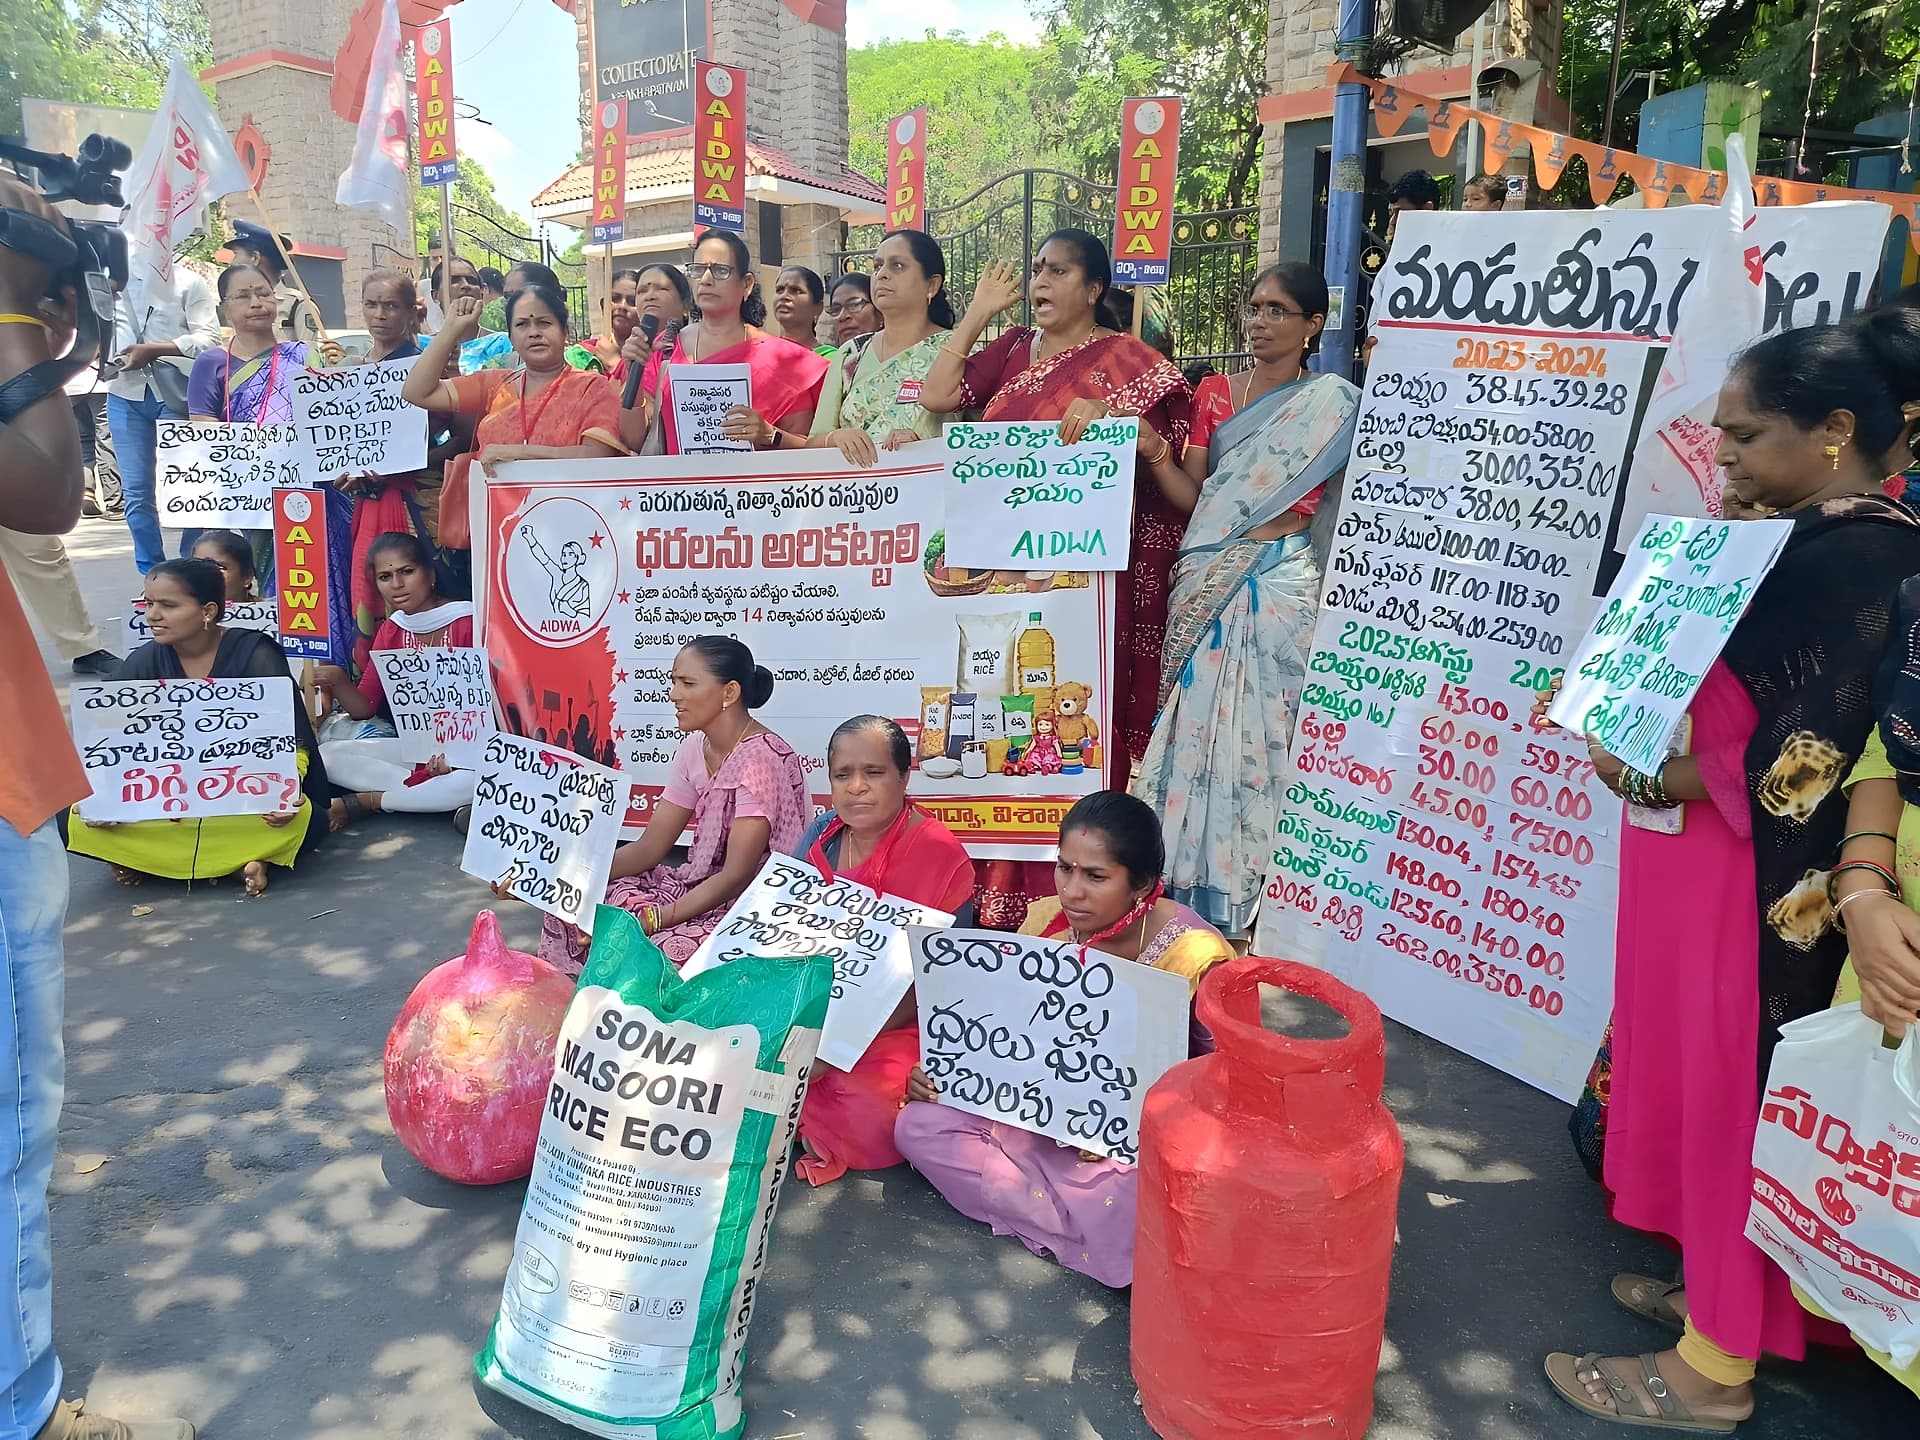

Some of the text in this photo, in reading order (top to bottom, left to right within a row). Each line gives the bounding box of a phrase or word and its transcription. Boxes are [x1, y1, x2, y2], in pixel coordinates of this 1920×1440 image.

[601, 48, 697, 86] COLLECTORATE
[424, 56, 448, 159] AIDWA
[701, 99, 735, 202] AIDWA
[597, 130, 618, 220] AIDWA
[891, 145, 917, 228] AIDW
[1122, 138, 1162, 254] AIDWA
[638, 481, 899, 520] పెరుగుతున్న నిత్యావసర వస్తువుల
[1004, 482, 1083, 509] భయం
[635, 521, 921, 588] ధరలను అరికట్టాలి
[1011, 530, 1107, 560] AIDWA
[285, 526, 320, 631] AIDWA
[635, 587, 660, 604] ప్రజా
[662, 584, 699, 600] పంపిణీ
[701, 585, 748, 608] వ్యవస్థను
[750, 583, 789, 604] పటిష్టం
[540, 619, 581, 633] AIDWA
[634, 606, 886, 628] రేషన్ షాపుల ద్వారా 14 నిత్యావసర వస్తువులను
[634, 632, 675, 649] ప్రజలకు
[774, 667, 810, 682] చదార,
[813, 664, 850, 686] పెట్రోల్,
[852, 662, 882, 681] డీజిల్
[883, 667, 915, 684] ధరలు
[973, 665, 995, 674] RICE
[167, 682, 265, 708] ధరలకు
[194, 707, 259, 734] లేదా
[630, 724, 654, 743] బ్లాక్
[922, 931, 1114, 999] ఆదాయం
[596, 1008, 699, 1067] SONA
[927, 999, 1035, 1061] ధరలు
[561, 1039, 724, 1116] MASOORI
[549, 1083, 610, 1142] RICE
[620, 1115, 713, 1161] ECO
